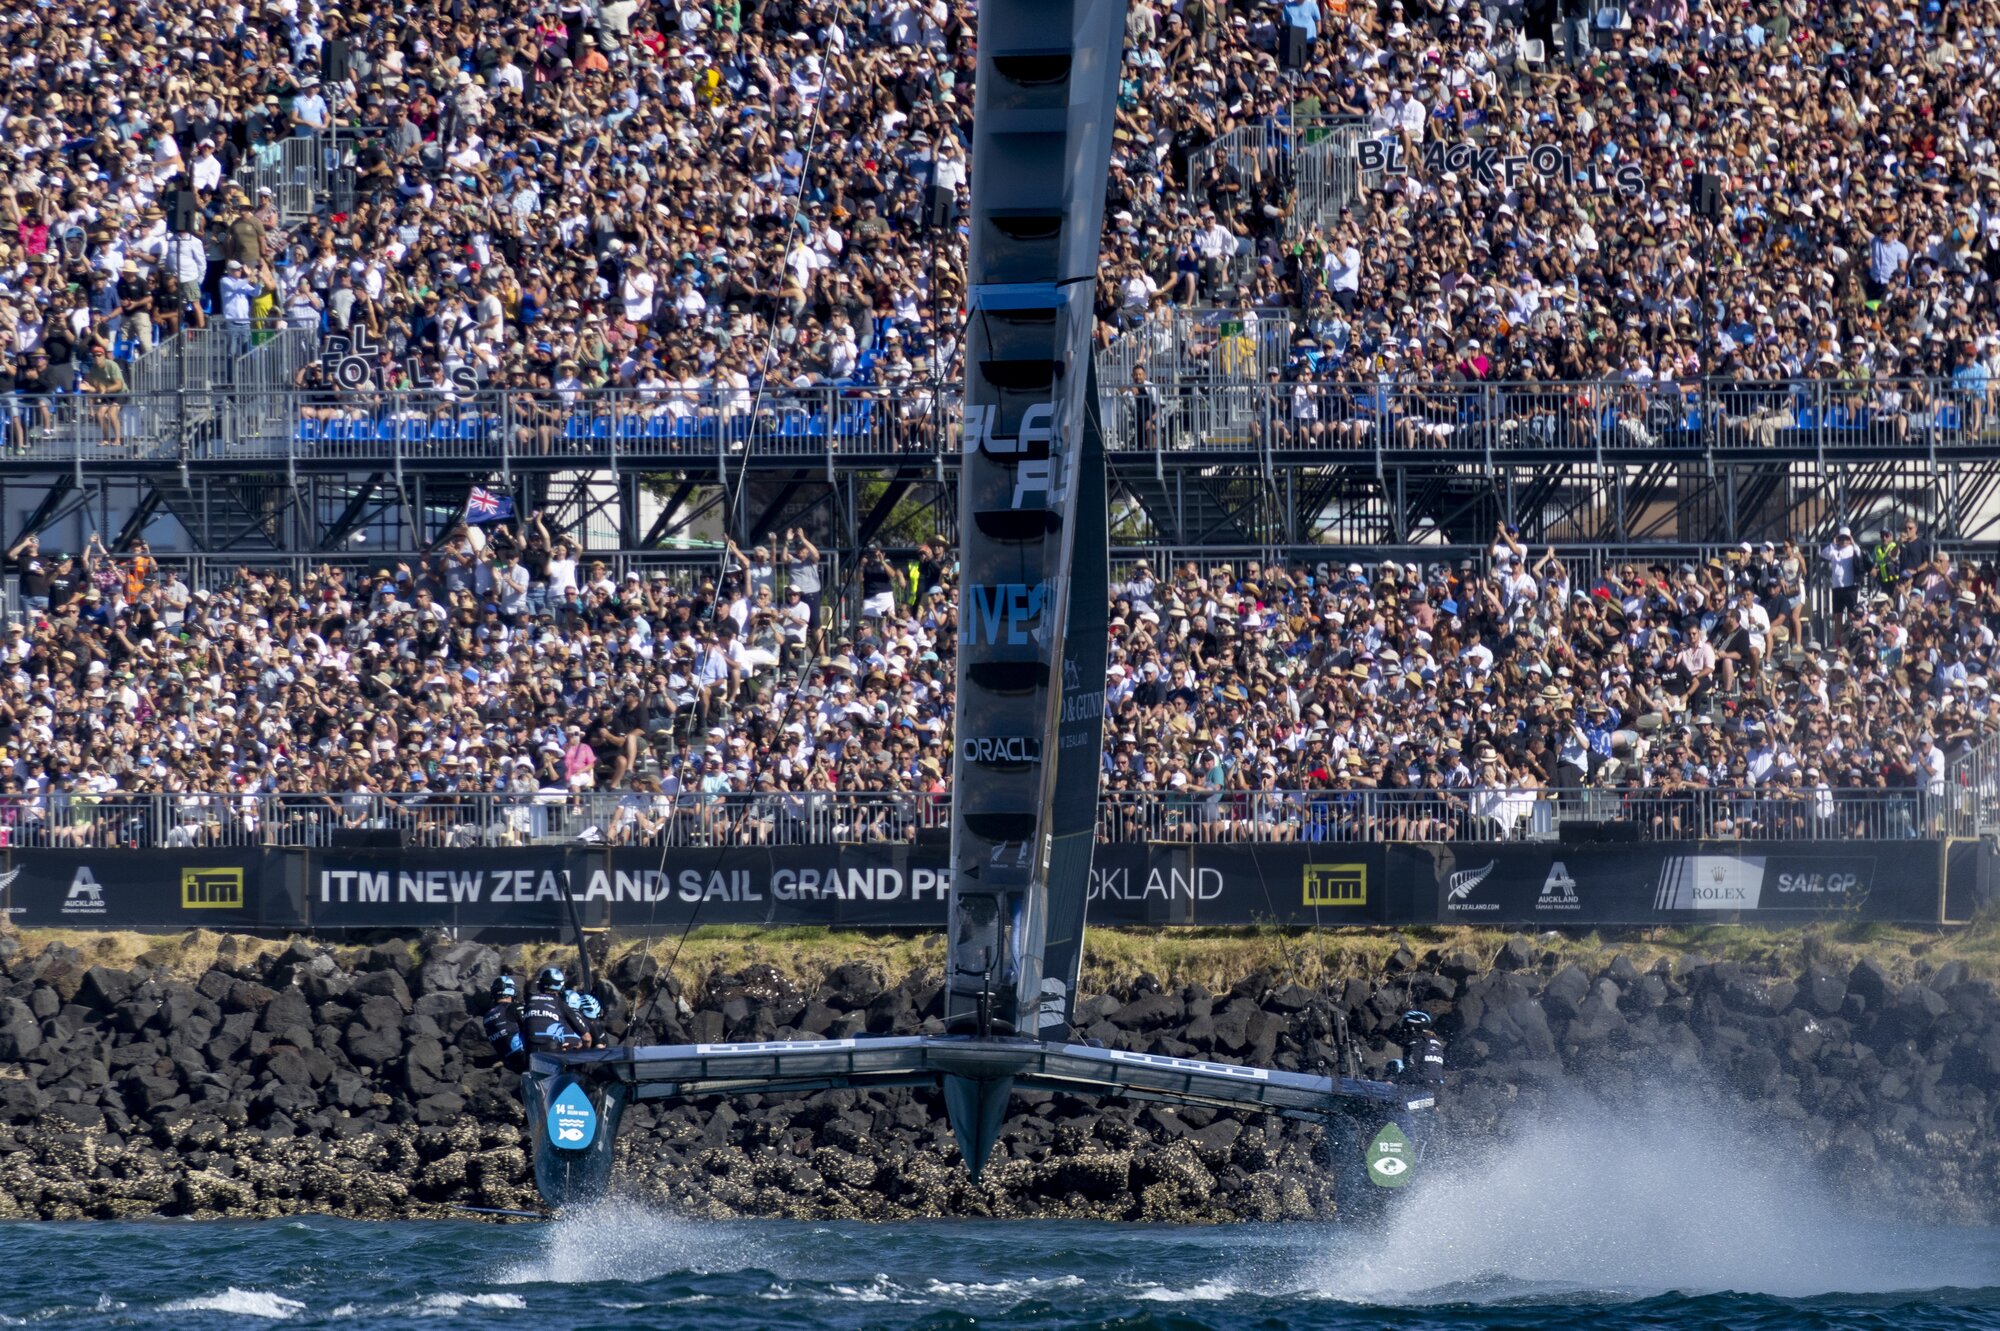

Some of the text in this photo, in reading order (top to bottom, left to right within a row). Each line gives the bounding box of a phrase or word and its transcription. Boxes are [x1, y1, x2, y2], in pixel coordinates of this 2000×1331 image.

[963, 738, 1040, 762] ORACL
[321, 870, 389, 902] ITM
[399, 870, 483, 902] NEW
[490, 870, 670, 902] ZEALAND
[678, 869, 762, 902] SAIL
[773, 868, 903, 901] GRAND
[1692, 888, 1746, 900] ROLEX
[555, 1104, 566, 1115] 14
[1379, 1142, 1389, 1152] 13
